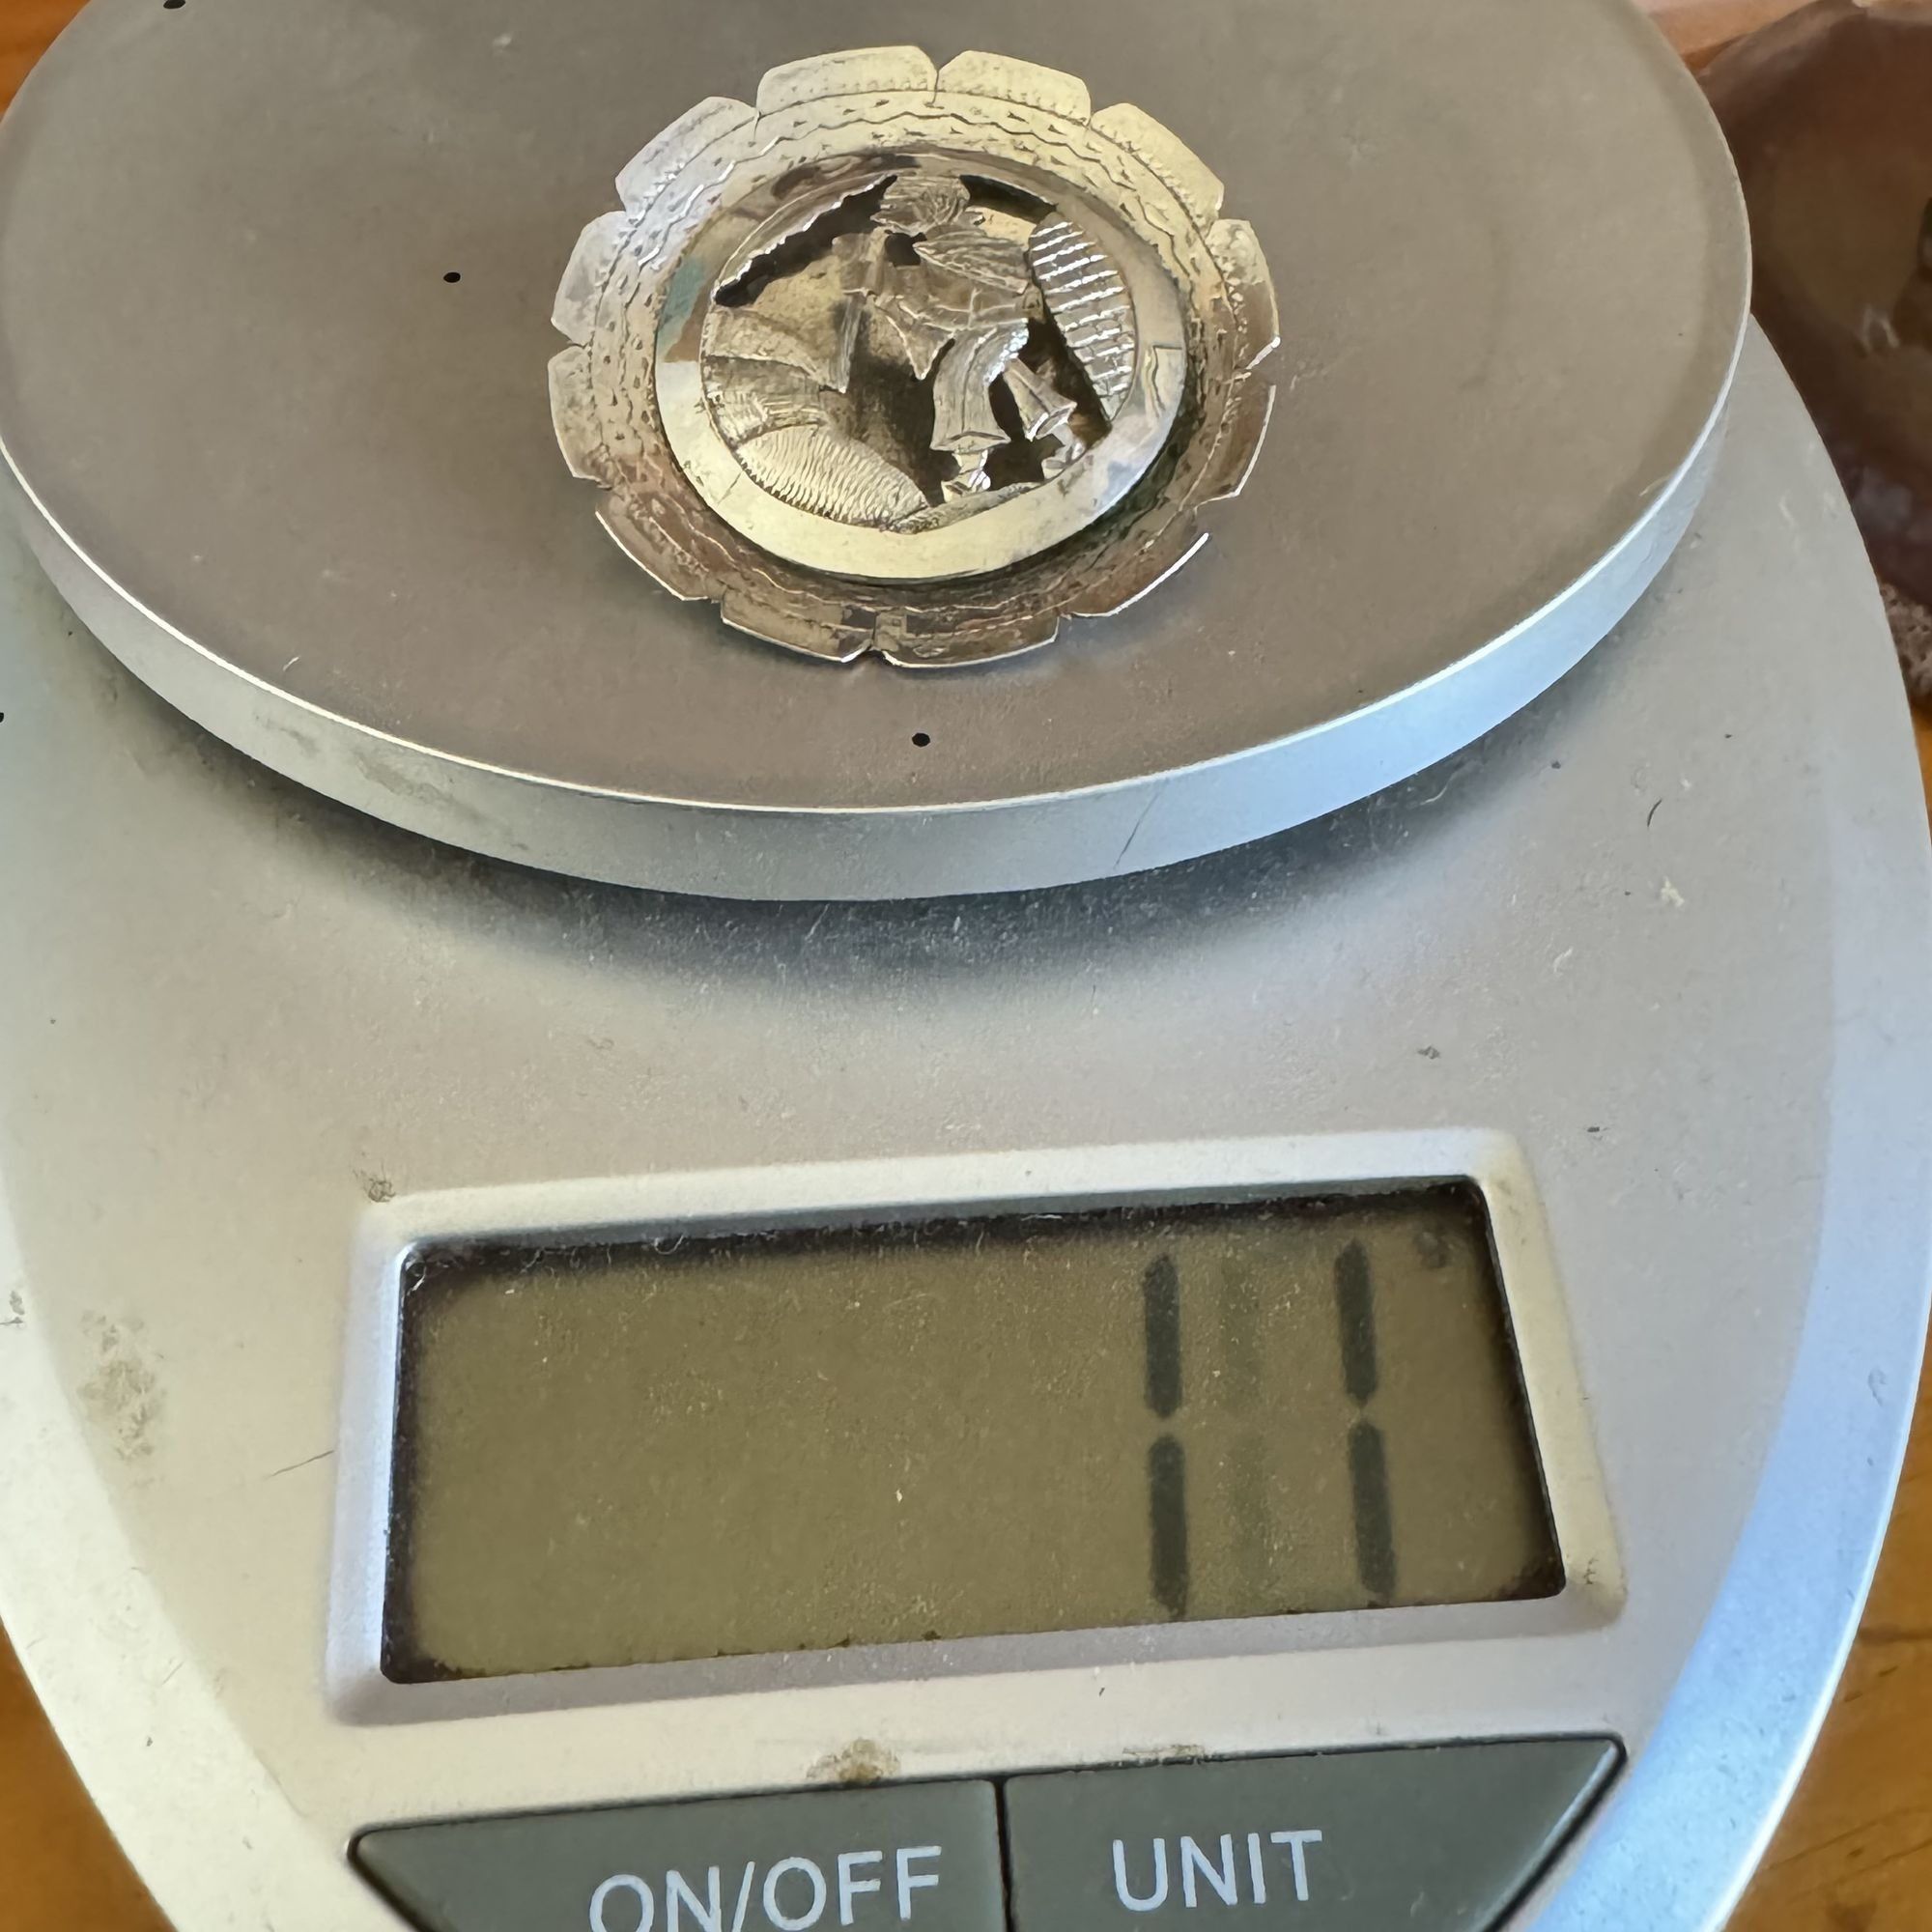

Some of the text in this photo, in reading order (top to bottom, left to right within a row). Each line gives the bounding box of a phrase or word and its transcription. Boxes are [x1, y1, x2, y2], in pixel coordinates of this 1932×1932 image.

[1142, 1240, 1397, 1618] 11
[589, 1846, 942, 1932] ON/OFF
[1113, 1830, 1322, 1912] UNIT
